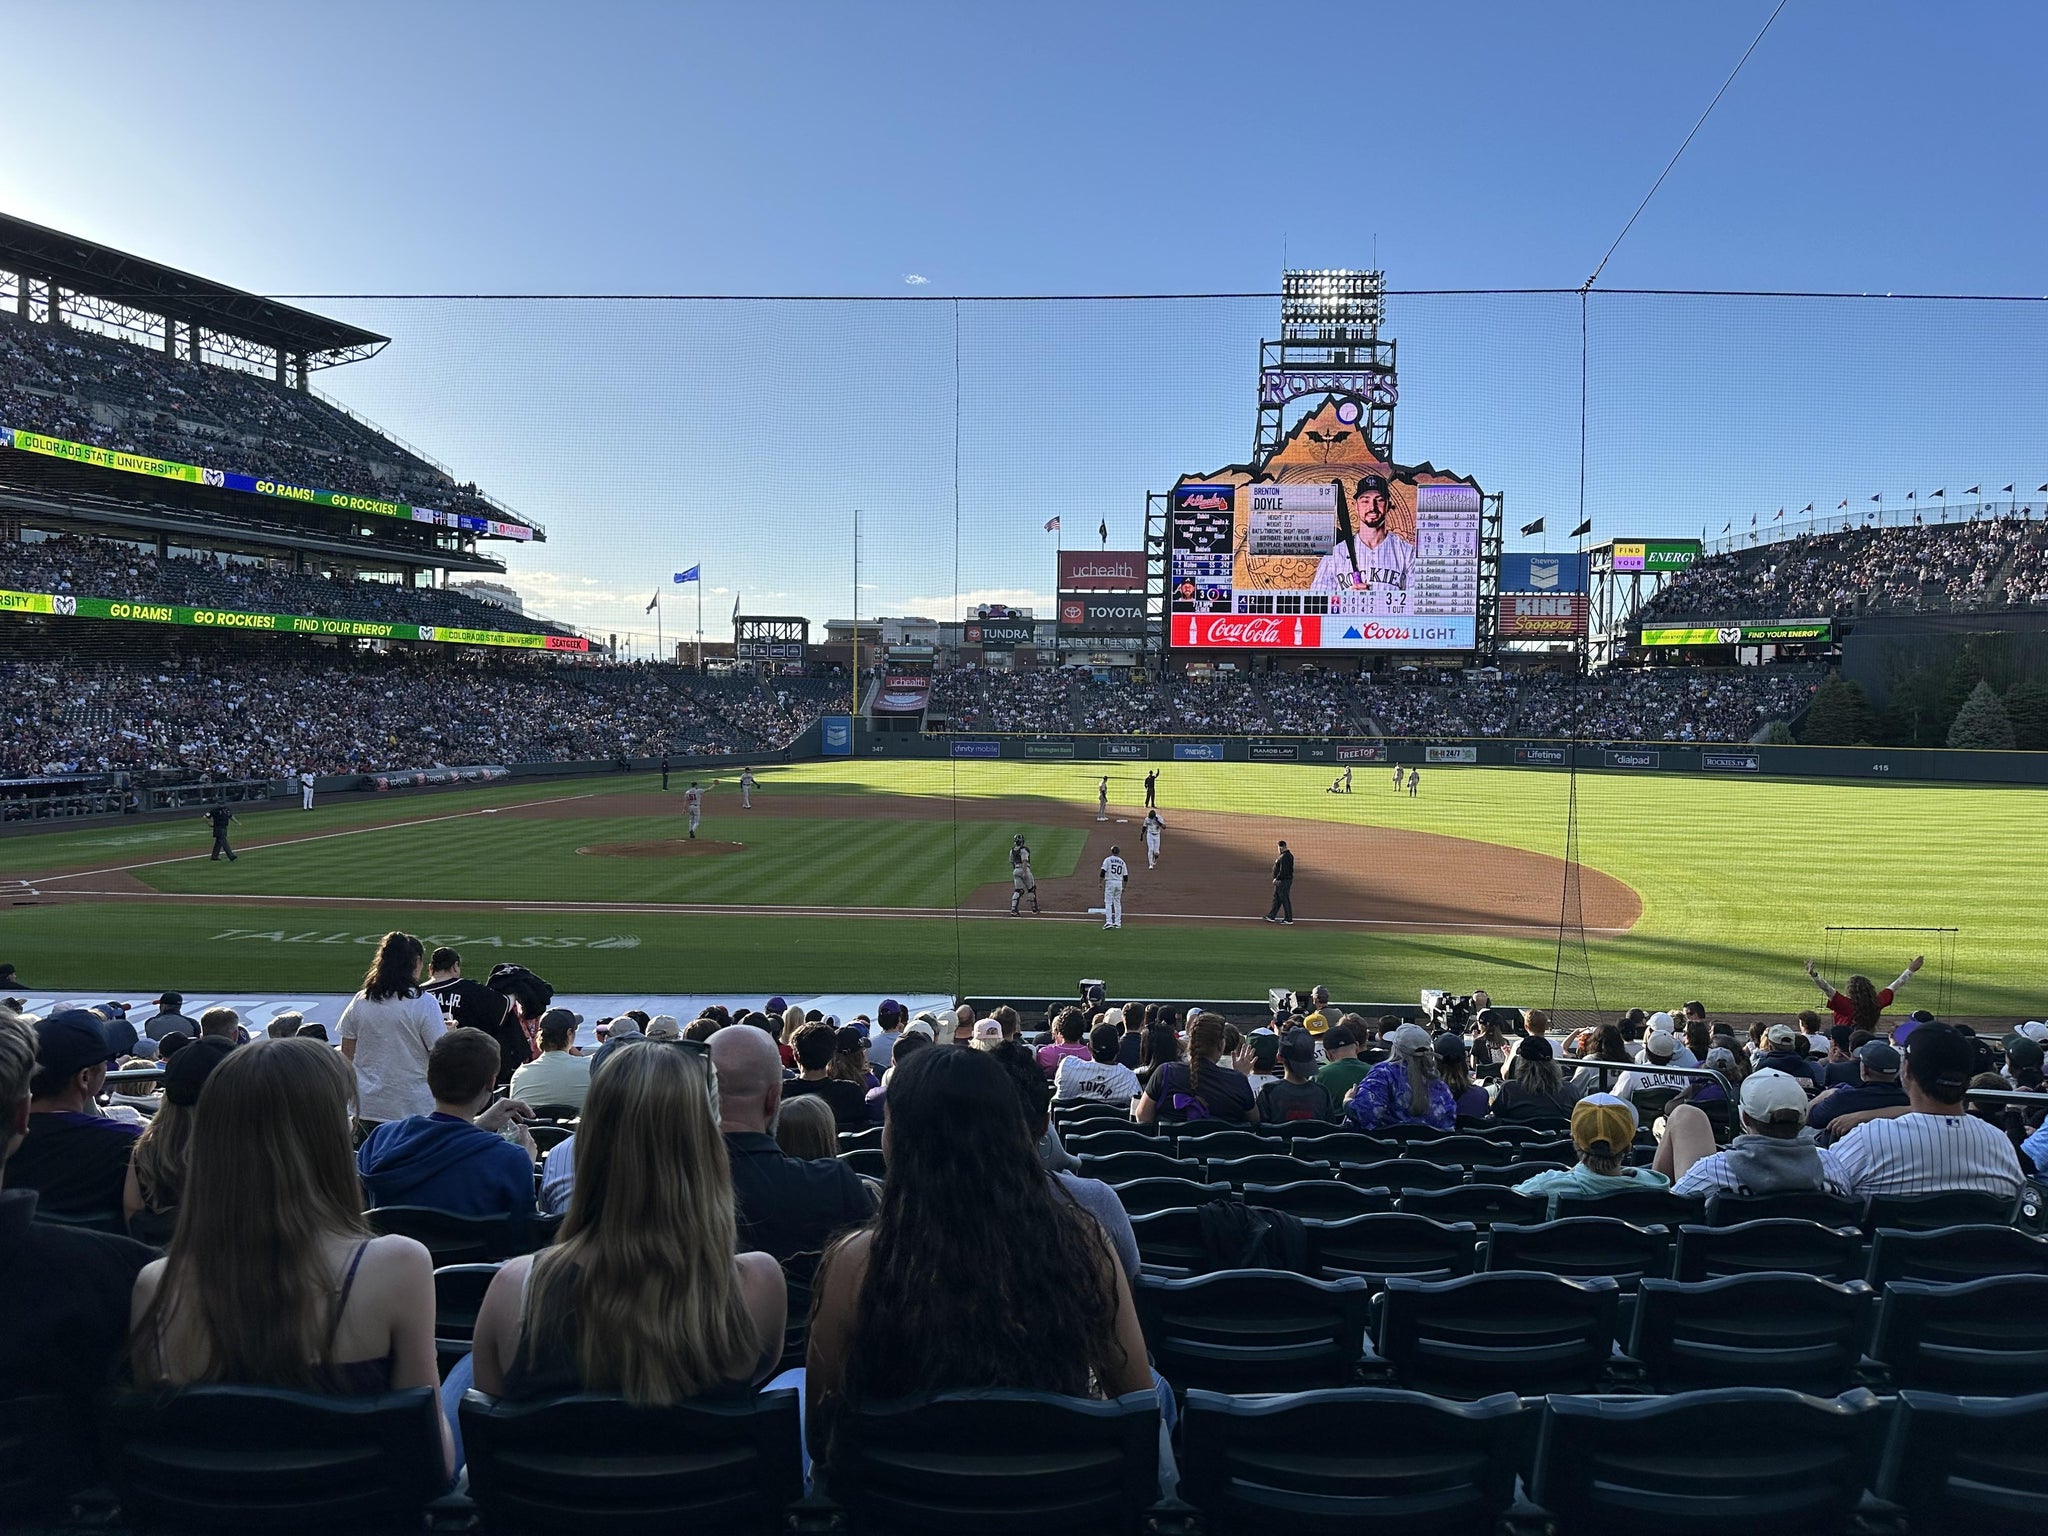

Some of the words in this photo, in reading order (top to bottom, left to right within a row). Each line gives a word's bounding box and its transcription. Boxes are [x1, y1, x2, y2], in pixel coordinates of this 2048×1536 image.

[1261, 371, 1399, 405] ROCKIES
[25, 436, 82, 457] COLORADO
[84, 449, 115, 464] STATE
[117, 453, 181, 476] UNIVERSITY
[256, 481, 275, 494] GO
[276, 484, 315, 501] RAMS!
[1254, 487, 1280, 496] BRENTON
[331, 494, 349, 507] GO
[350, 497, 397, 515] ROCKIES!
[1254, 497, 1283, 510] DOYLE
[1647, 552, 1696, 563] ENERGY
[1072, 562, 1133, 577] uchealth
[1200, 590, 1205, 599] 3
[1222, 590, 1228, 599] 4
[1250, 596, 1256, 604] 2
[110, 604, 131, 617] GO
[132, 605, 173, 621] RAMS!
[1088, 607, 1143, 618] TOYOTA
[1515, 598, 1572, 616] KING
[194, 611, 214, 624] GO
[216, 613, 275, 628] ROCKIES!
[1514, 615, 1572, 632] Soopers
[293, 619, 319, 631] FIND
[322, 620, 350, 633] YOUR
[352, 623, 393, 636] ENERGY
[982, 629, 1029, 639] TUNDRA
[1363, 621, 1410, 640] Coors
[1413, 629, 1456, 640] LIGHT
[1787, 630, 1819, 638] ENERGY
[448, 631, 485, 641] COLORADO
[486, 634, 505, 643] STATE
[506, 636, 542, 645] UNIVERSITY
[551, 638, 582, 649] SEATGEEK
[890, 677, 926, 687] uchealth
[1527, 750, 1562, 759] Lifetime
[1617, 755, 1650, 765] dialpad
[1110, 864, 1123, 875] 50
[1640, 1074, 1685, 1089] BLACKMON
[1079, 1081, 1112, 1099] TOVAR
